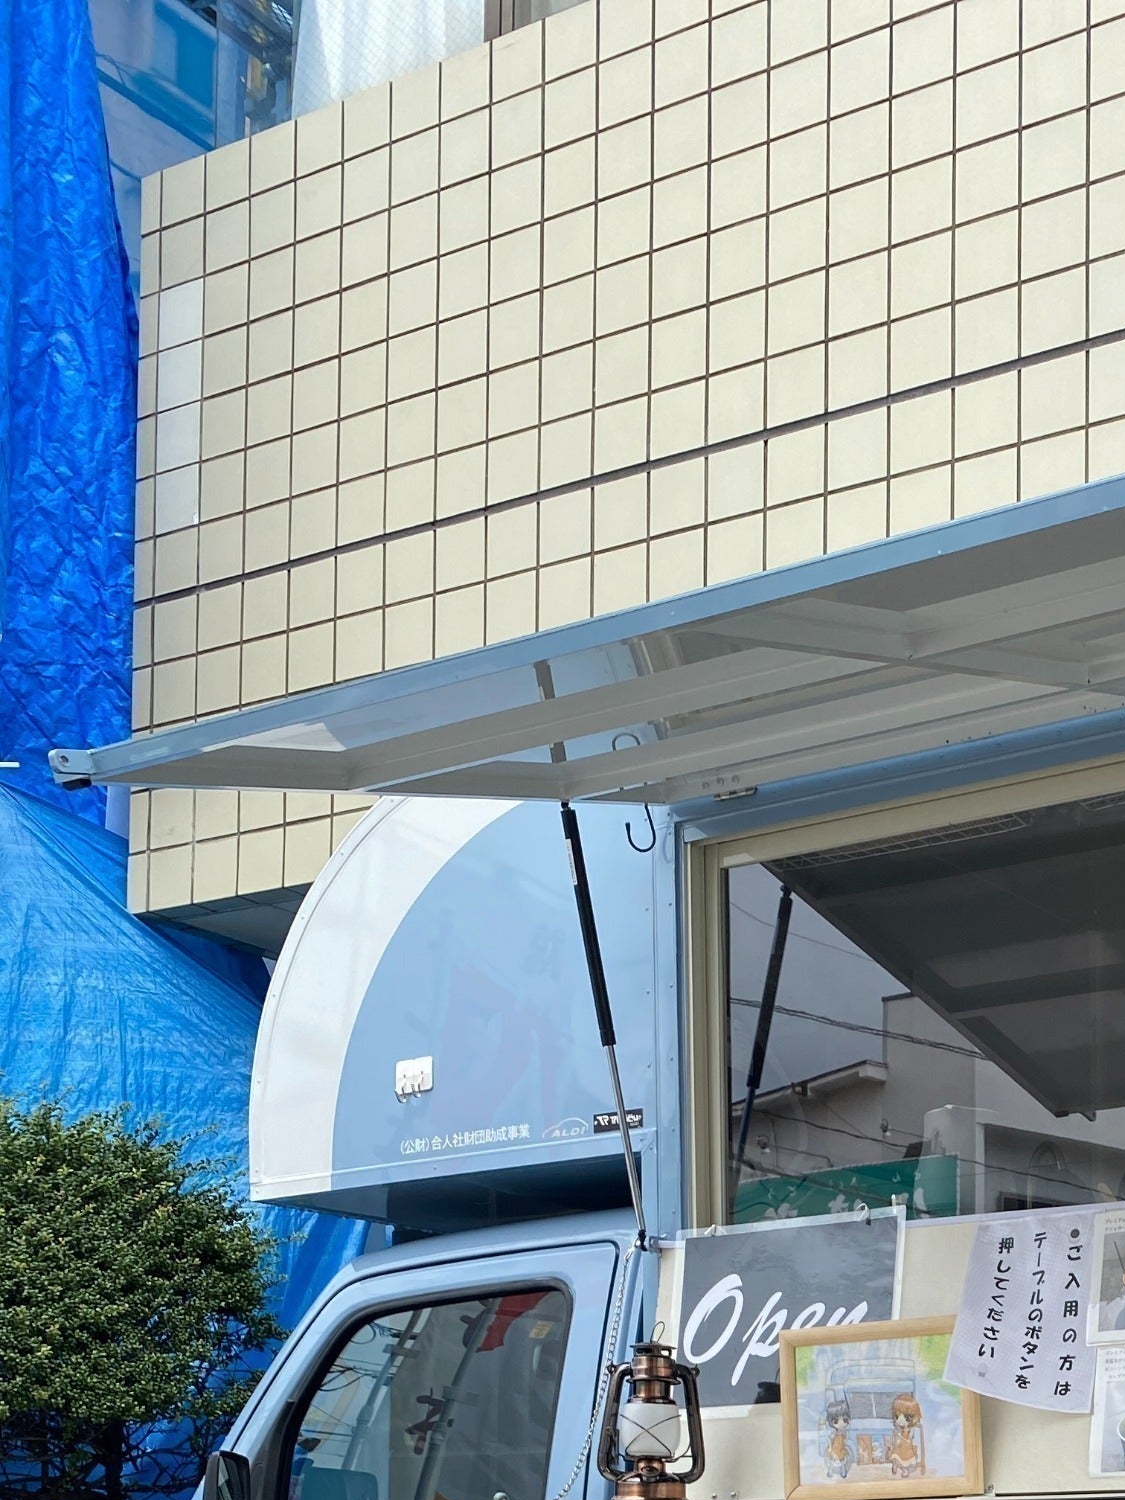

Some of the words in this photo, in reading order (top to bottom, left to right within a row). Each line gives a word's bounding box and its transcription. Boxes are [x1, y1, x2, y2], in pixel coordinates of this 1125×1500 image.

[400, 1123, 530, 1155] (公財)合人社財団助成事業
[552, 1125, 586, 1138] ALDI
[977, 1236, 1015, 1358] 押してください
[1014, 1231, 1048, 1390] テーブルのボタンを
[1054, 1244, 1083, 1396] ご入用の方は
